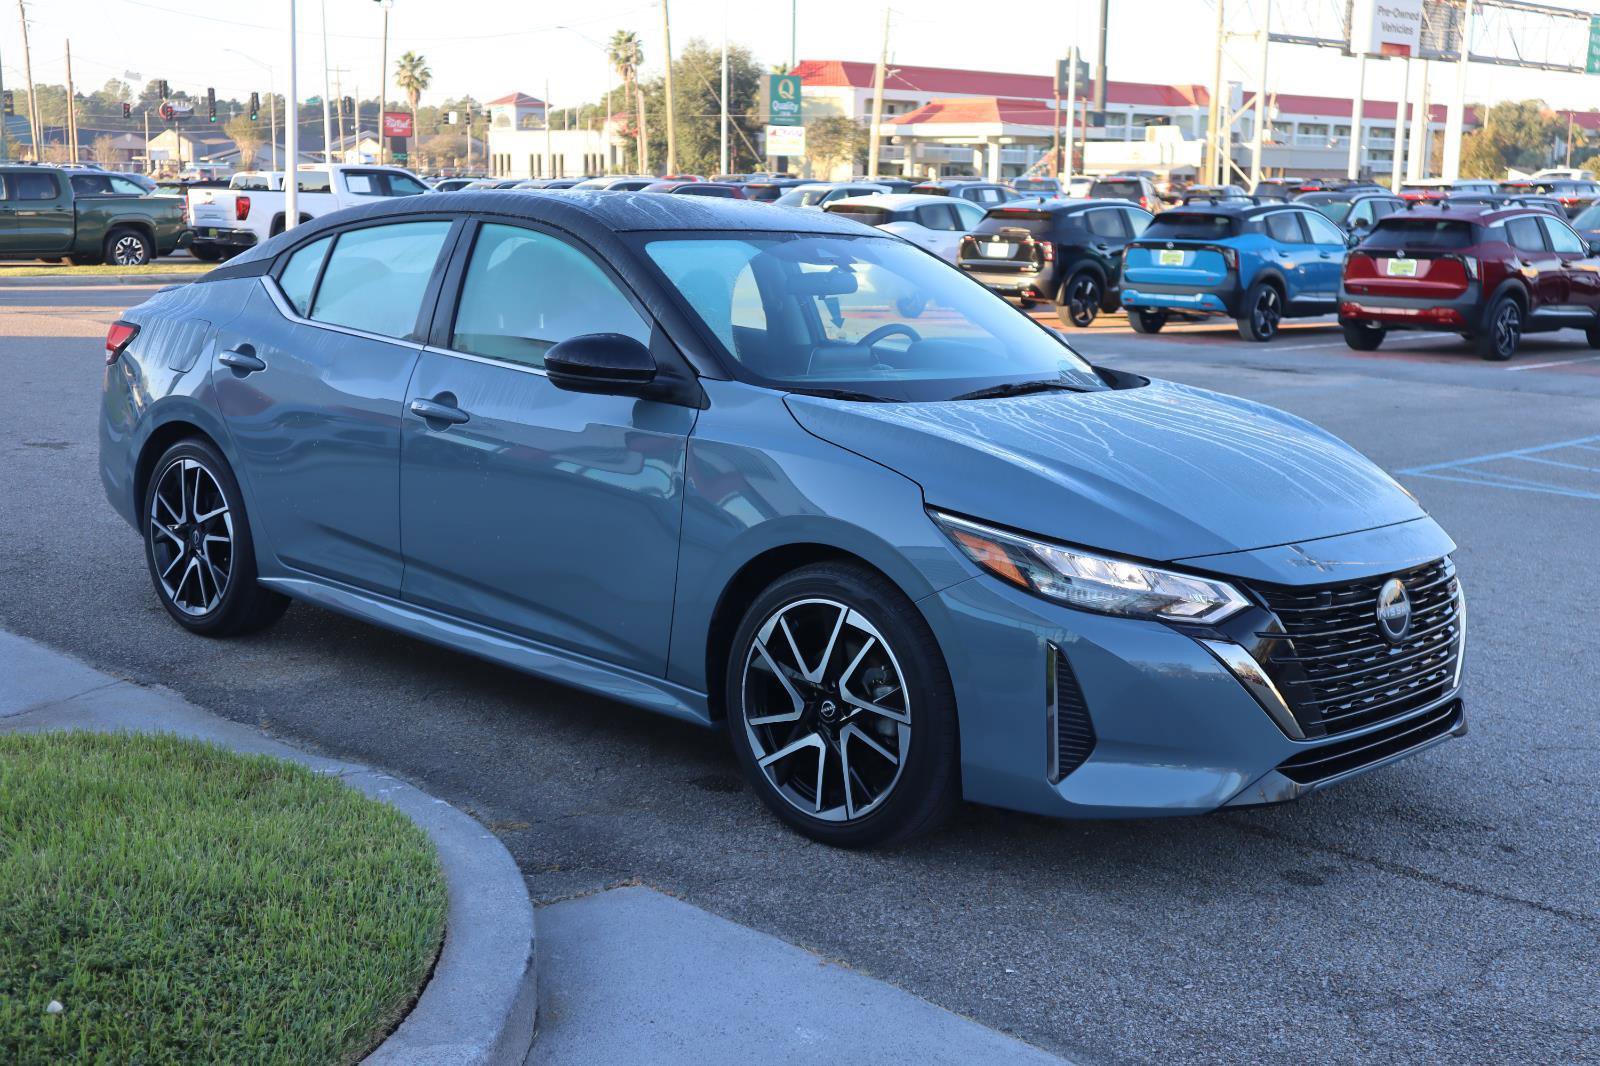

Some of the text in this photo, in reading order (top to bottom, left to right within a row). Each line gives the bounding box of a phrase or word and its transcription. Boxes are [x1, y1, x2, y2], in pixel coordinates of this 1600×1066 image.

[1377, 6, 1419, 20] Pre-Owned
[1382, 22, 1413, 34] Vehicles
[778, 79, 795, 99] Q
[772, 100, 799, 112] Quality
